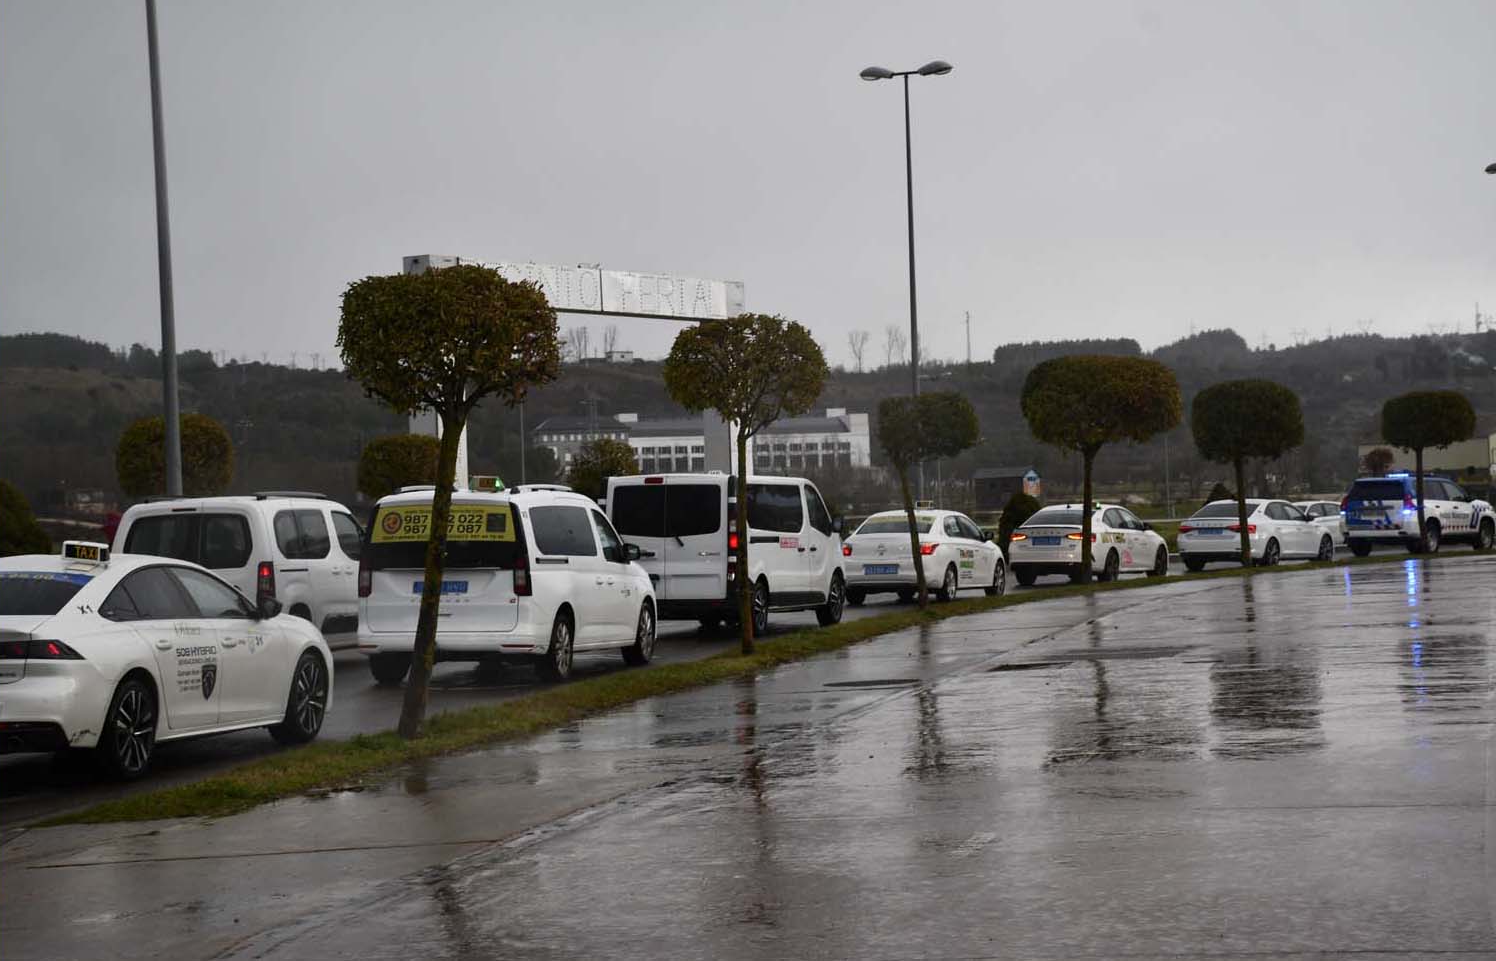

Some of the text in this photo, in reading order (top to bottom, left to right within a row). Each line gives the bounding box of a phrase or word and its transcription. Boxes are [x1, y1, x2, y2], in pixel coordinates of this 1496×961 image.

[404, 514, 428, 524] 987
[458, 514, 483, 524] 022
[404, 524, 428, 534] 987
[457, 524, 482, 534] 087
[76, 546, 98, 560] TAXI
